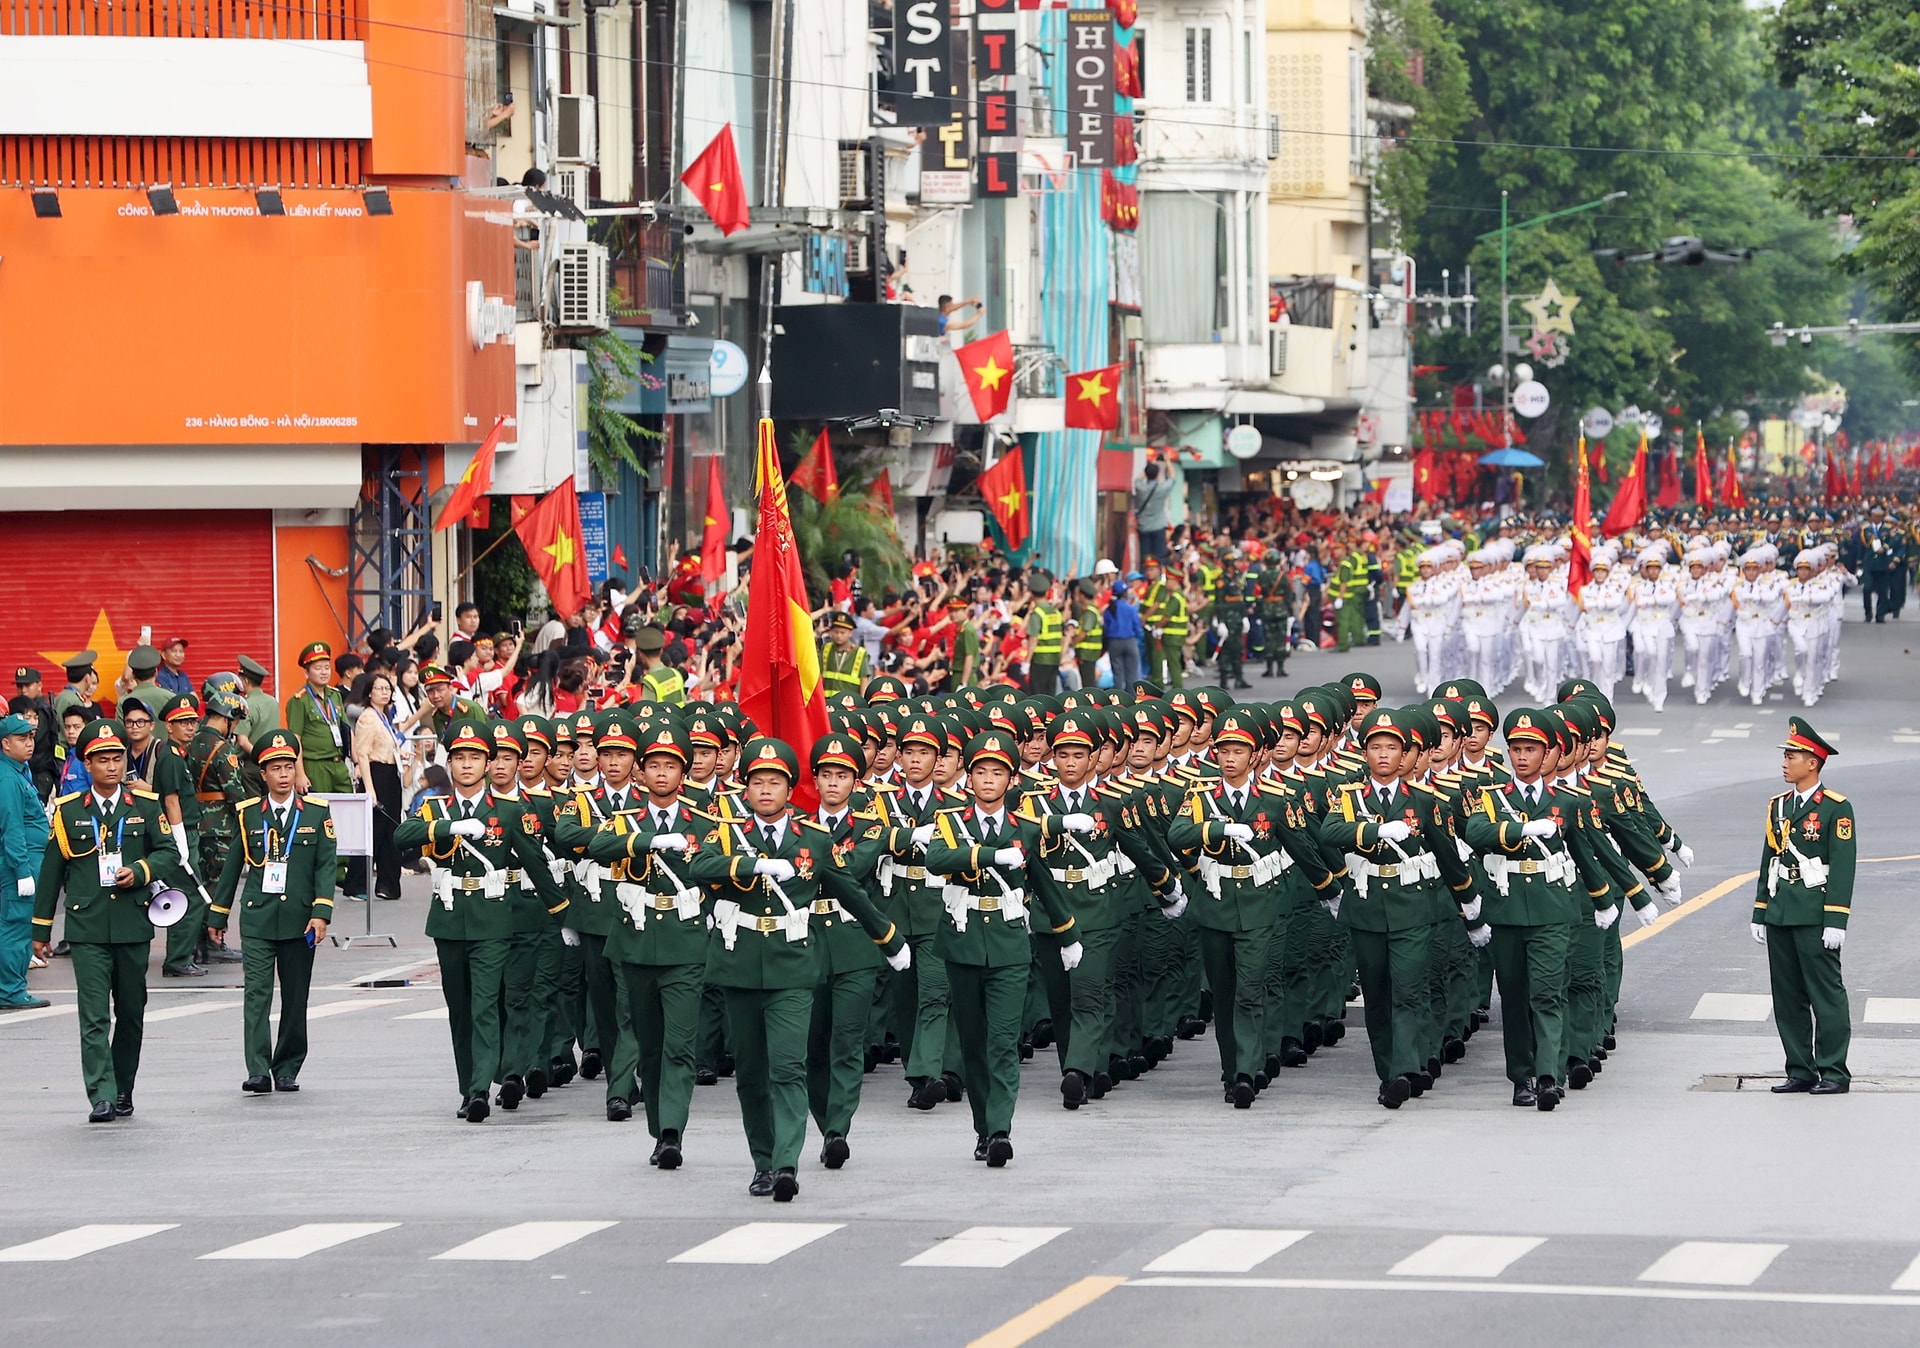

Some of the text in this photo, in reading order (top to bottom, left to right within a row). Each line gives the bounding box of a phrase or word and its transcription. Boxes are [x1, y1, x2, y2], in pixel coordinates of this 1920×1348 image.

[981, 0, 1008, 192] TEL
[1075, 26, 1106, 164] HOTEL
[117, 202, 148, 216] CÔNG
[181, 200, 209, 216] PHẦN
[210, 206, 255, 216] THƯƠNG
[289, 203, 311, 216] LIÊN
[312, 202, 332, 216] KẾT
[334, 207, 363, 217] NANO
[185, 417, 203, 427] 236
[209, 414, 239, 427] HÀNG
[240, 414, 270, 427] BÔNG
[277, 414, 292, 427] HÀ
[107, 866, 116, 874] N
[270, 873, 280, 881] N
